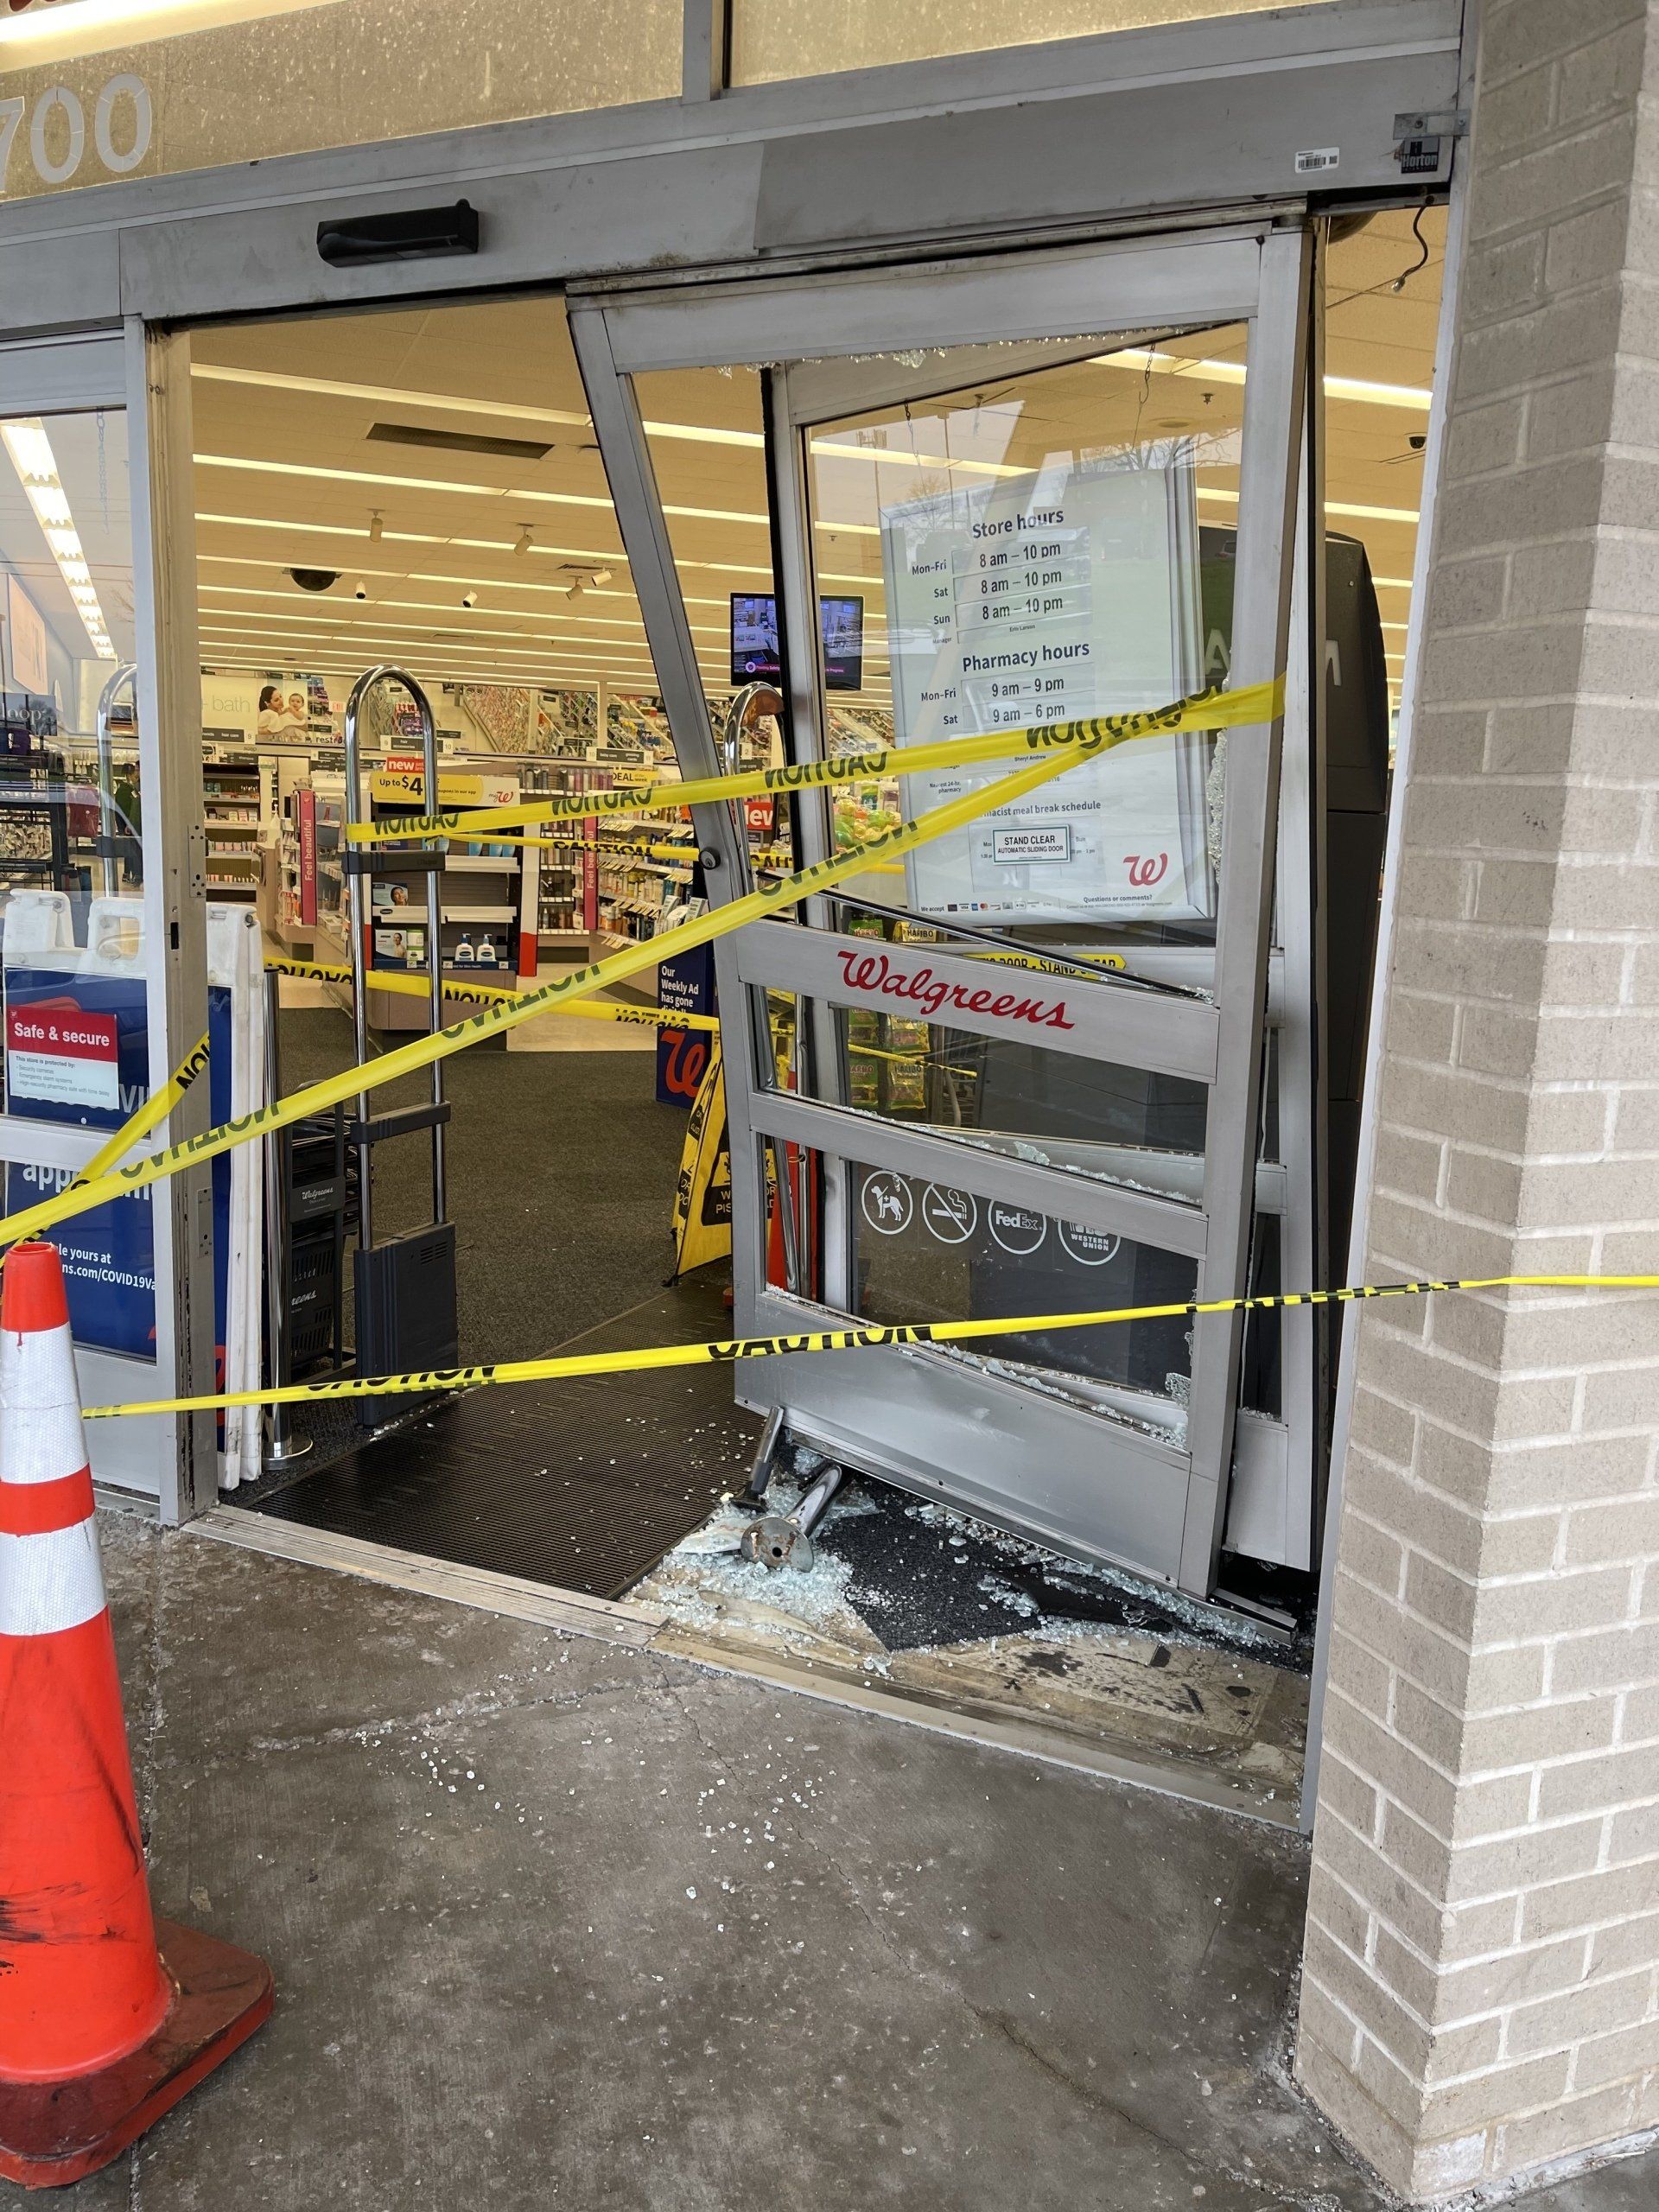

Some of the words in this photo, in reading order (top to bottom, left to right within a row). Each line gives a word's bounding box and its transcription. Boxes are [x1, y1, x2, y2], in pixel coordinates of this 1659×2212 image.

[1402, 155, 1438, 168] Horton
[973, 520, 1013, 538] Store
[1017, 510, 1064, 531] hours
[912, 559, 946, 575] Mon-Fri
[980, 554, 986, 567] 8
[990, 553, 1007, 566] am
[1023, 544, 1037, 561] 10
[1041, 543, 1061, 558] pm
[934, 588, 948, 598] Sat
[981, 580, 988, 594] 8
[991, 579, 1008, 593] am
[1025, 571, 1038, 587] 10
[1043, 570, 1062, 586] pm
[934, 615, 950, 625] Sun
[982, 606, 988, 620] 8
[993, 605, 1010, 619] am
[1026, 598, 1039, 613] 10
[1044, 597, 1063, 613] pm
[963, 650, 1038, 672] Pharmacy
[1043, 643, 1090, 661] hours
[921, 688, 957, 702] Mon-Fri
[992, 683, 998, 697] 9
[1002, 683, 1020, 696] am
[1034, 678, 1041, 691] 9
[1046, 677, 1065, 692] pm
[213, 694, 251, 713] bath
[944, 715, 958, 725] Sat
[994, 709, 1000, 722] 9
[1004, 709, 1020, 722] am
[1036, 704, 1043, 718] 6
[1046, 704, 1065, 721] pm
[388, 760, 415, 771] new
[379, 779, 391, 787] Up
[402, 775, 423, 796] $4
[613, 772, 634, 782] DEAL
[1013, 805, 1033, 816] meal
[1035, 803, 1059, 814] break
[1061, 801, 1101, 812] schedule
[1004, 836, 1029, 846] STAND
[1030, 835, 1056, 844] CLEAR
[907, 928, 934, 938] HARIBO
[661, 965, 676, 977] Our
[661, 978, 688, 995] Weekly
[689, 983, 699, 995] Ad
[837, 950, 1075, 1030] Walgreens
[661, 991, 674, 1004] has
[675, 997, 694, 1007] gone
[14, 1022, 45, 1039] Safe
[48, 1026, 59, 1041] &
[62, 1030, 110, 1047] secure
[715, 1204, 732, 1215] PIS
[995, 1210, 1039, 1231] FedEx
[1071, 1233, 1109, 1245] WESTERN
[1082, 1242, 1109, 1252] UNION
[70, 1248, 99, 1263] yours
[100, 1252, 111, 1265] at
